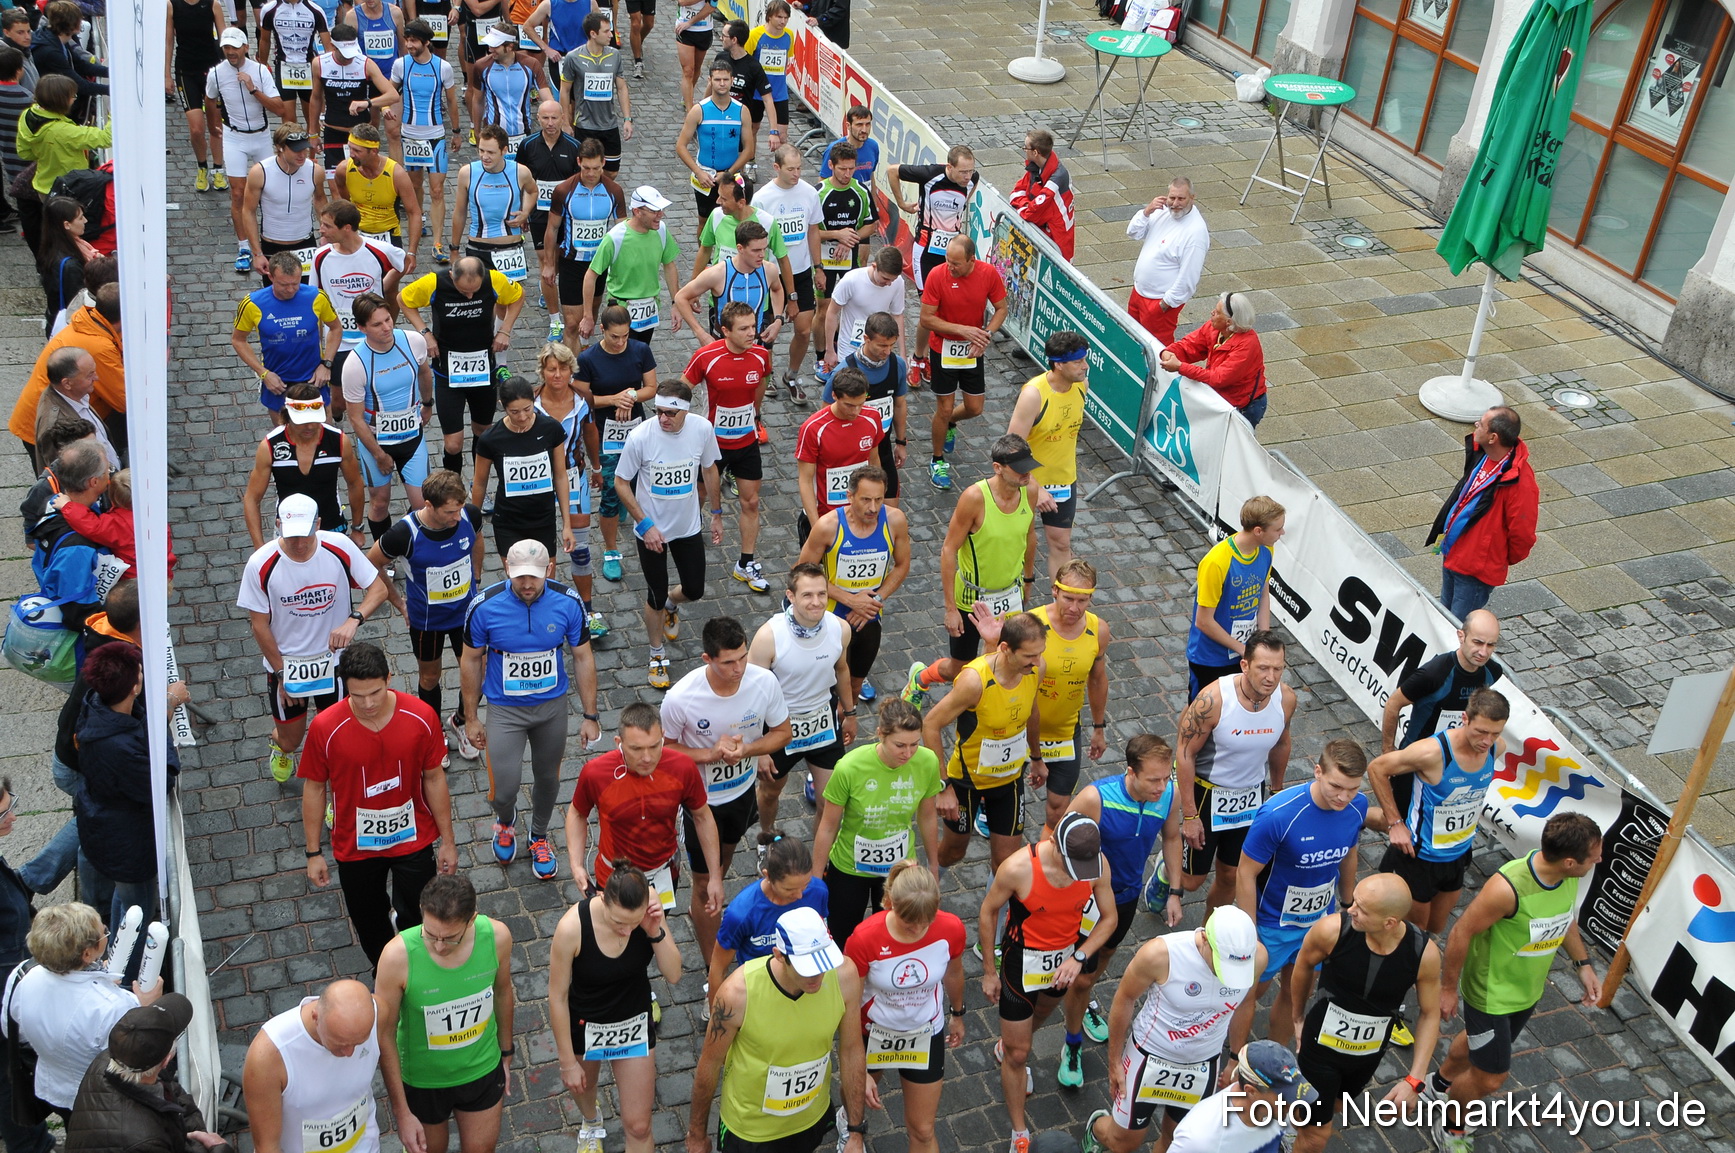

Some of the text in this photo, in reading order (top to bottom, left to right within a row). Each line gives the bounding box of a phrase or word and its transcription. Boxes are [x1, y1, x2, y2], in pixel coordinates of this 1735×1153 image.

[368, 38, 393, 48] 2200
[765, 56, 782, 66] 245
[288, 69, 306, 79] 166
[325, 80, 361, 89] Energizer
[587, 80, 611, 91] 2707
[405, 144, 430, 157] 2028
[576, 227, 604, 241] 2283
[495, 255, 523, 271] 2042
[347, 281, 371, 289] JANIG
[446, 306, 483, 319] Linzer
[631, 304, 656, 320] 2704
[1037, 295, 1061, 328] Mehr
[1055, 280, 1106, 334] Event-Leit-Systeme
[1035, 315, 1048, 338] für
[452, 359, 486, 373] 2473
[381, 415, 415, 432] 2006
[719, 412, 751, 428] 2017
[1097, 409, 1112, 429] 6352
[509, 463, 547, 482] 2022
[654, 468, 691, 486] 2389
[521, 481, 538, 491] Karla
[665, 486, 680, 495] Hans
[1184, 479, 1200, 498] GmbH
[443, 570, 461, 589] 69
[846, 563, 877, 579] 323
[850, 579, 870, 588] Mario
[280, 588, 328, 604] GERHART
[302, 593, 333, 606] JANIG
[442, 587, 464, 598] Marcel
[1268, 576, 1301, 614] erbinden
[993, 598, 1010, 616] 58
[1329, 575, 1428, 689] SW
[287, 660, 330, 681] 2007
[509, 660, 553, 679] 2890
[519, 679, 543, 690] Robert
[1243, 727, 1275, 736] KLEBL
[1001, 747, 1012, 763] 3
[712, 757, 752, 783] 2012
[991, 763, 1016, 773] Thomas
[1217, 791, 1257, 814] 2232
[362, 813, 410, 835] 2853
[1444, 811, 1476, 832] 612
[373, 833, 401, 845] Florian
[860, 842, 905, 863] 2331
[1300, 845, 1349, 864] SYSCAD
[1629, 849, 1652, 868] Wasse
[1621, 869, 1644, 887] Wärm
[1289, 890, 1331, 913] 2430
[1612, 887, 1638, 905] Freize
[1533, 939, 1560, 950] Richard
[1041, 951, 1063, 972] 56
[426, 997, 484, 1017] PARTL Neumarkt
[441, 1004, 483, 1032] 177
[448, 1027, 478, 1043] Martin
[592, 1024, 642, 1048] 2252
[1334, 1020, 1375, 1042] 210
[1334, 1037, 1368, 1052] Thomas
[877, 1053, 917, 1063] Stephanie
[769, 1068, 793, 1077] PARTL
[1154, 1069, 1196, 1091] 213
[782, 1070, 819, 1097] 152
[782, 1095, 811, 1110] Jürgen
[1151, 1088, 1187, 1102] Matthias
[303, 1104, 359, 1131] PARTL Neumarkt
[319, 1115, 358, 1148] 651
